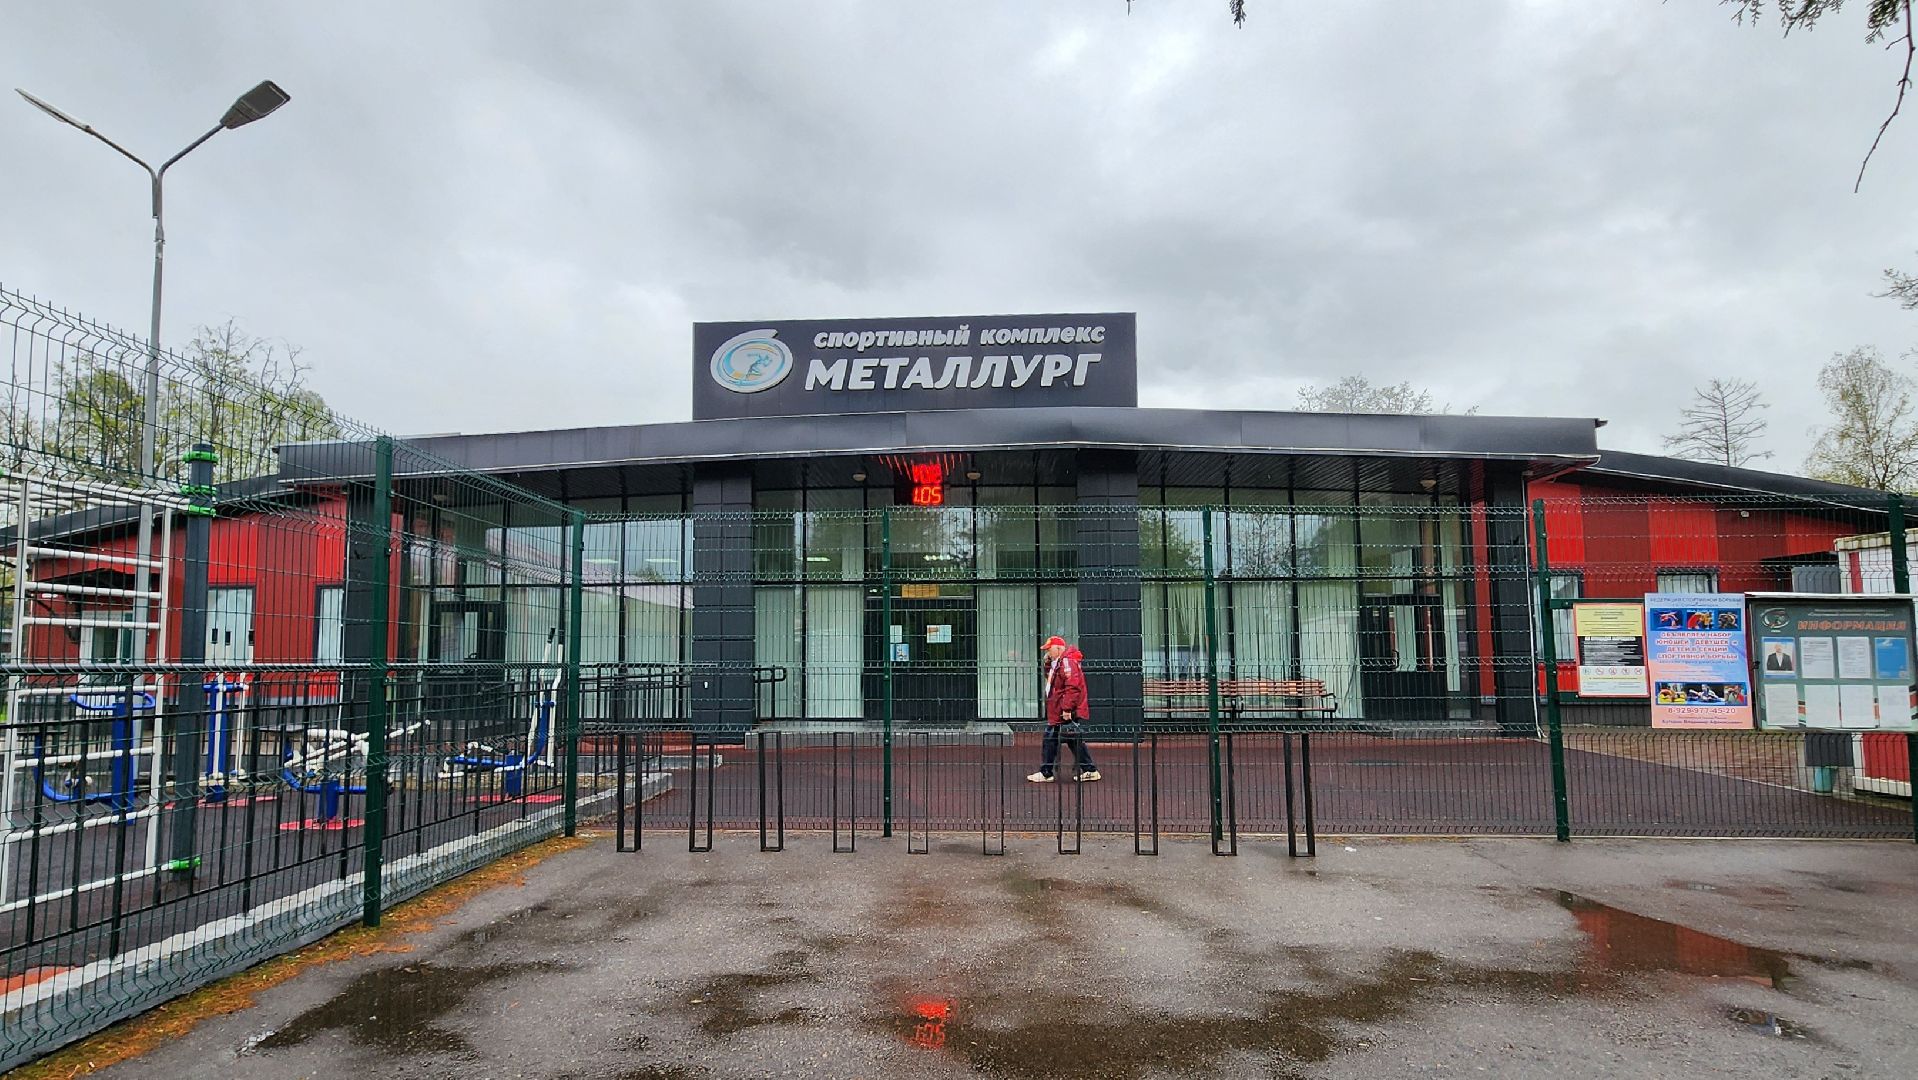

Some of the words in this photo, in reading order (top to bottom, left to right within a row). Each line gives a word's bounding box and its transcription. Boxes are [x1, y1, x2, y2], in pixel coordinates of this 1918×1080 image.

[813, 324, 971, 352] спортивный
[980, 326, 1106, 346] комплекс
[805, 353, 1103, 391] МЕТАЛЛУРГ
[1797, 619, 1907, 632] ИНФОРМАЦИЯ
